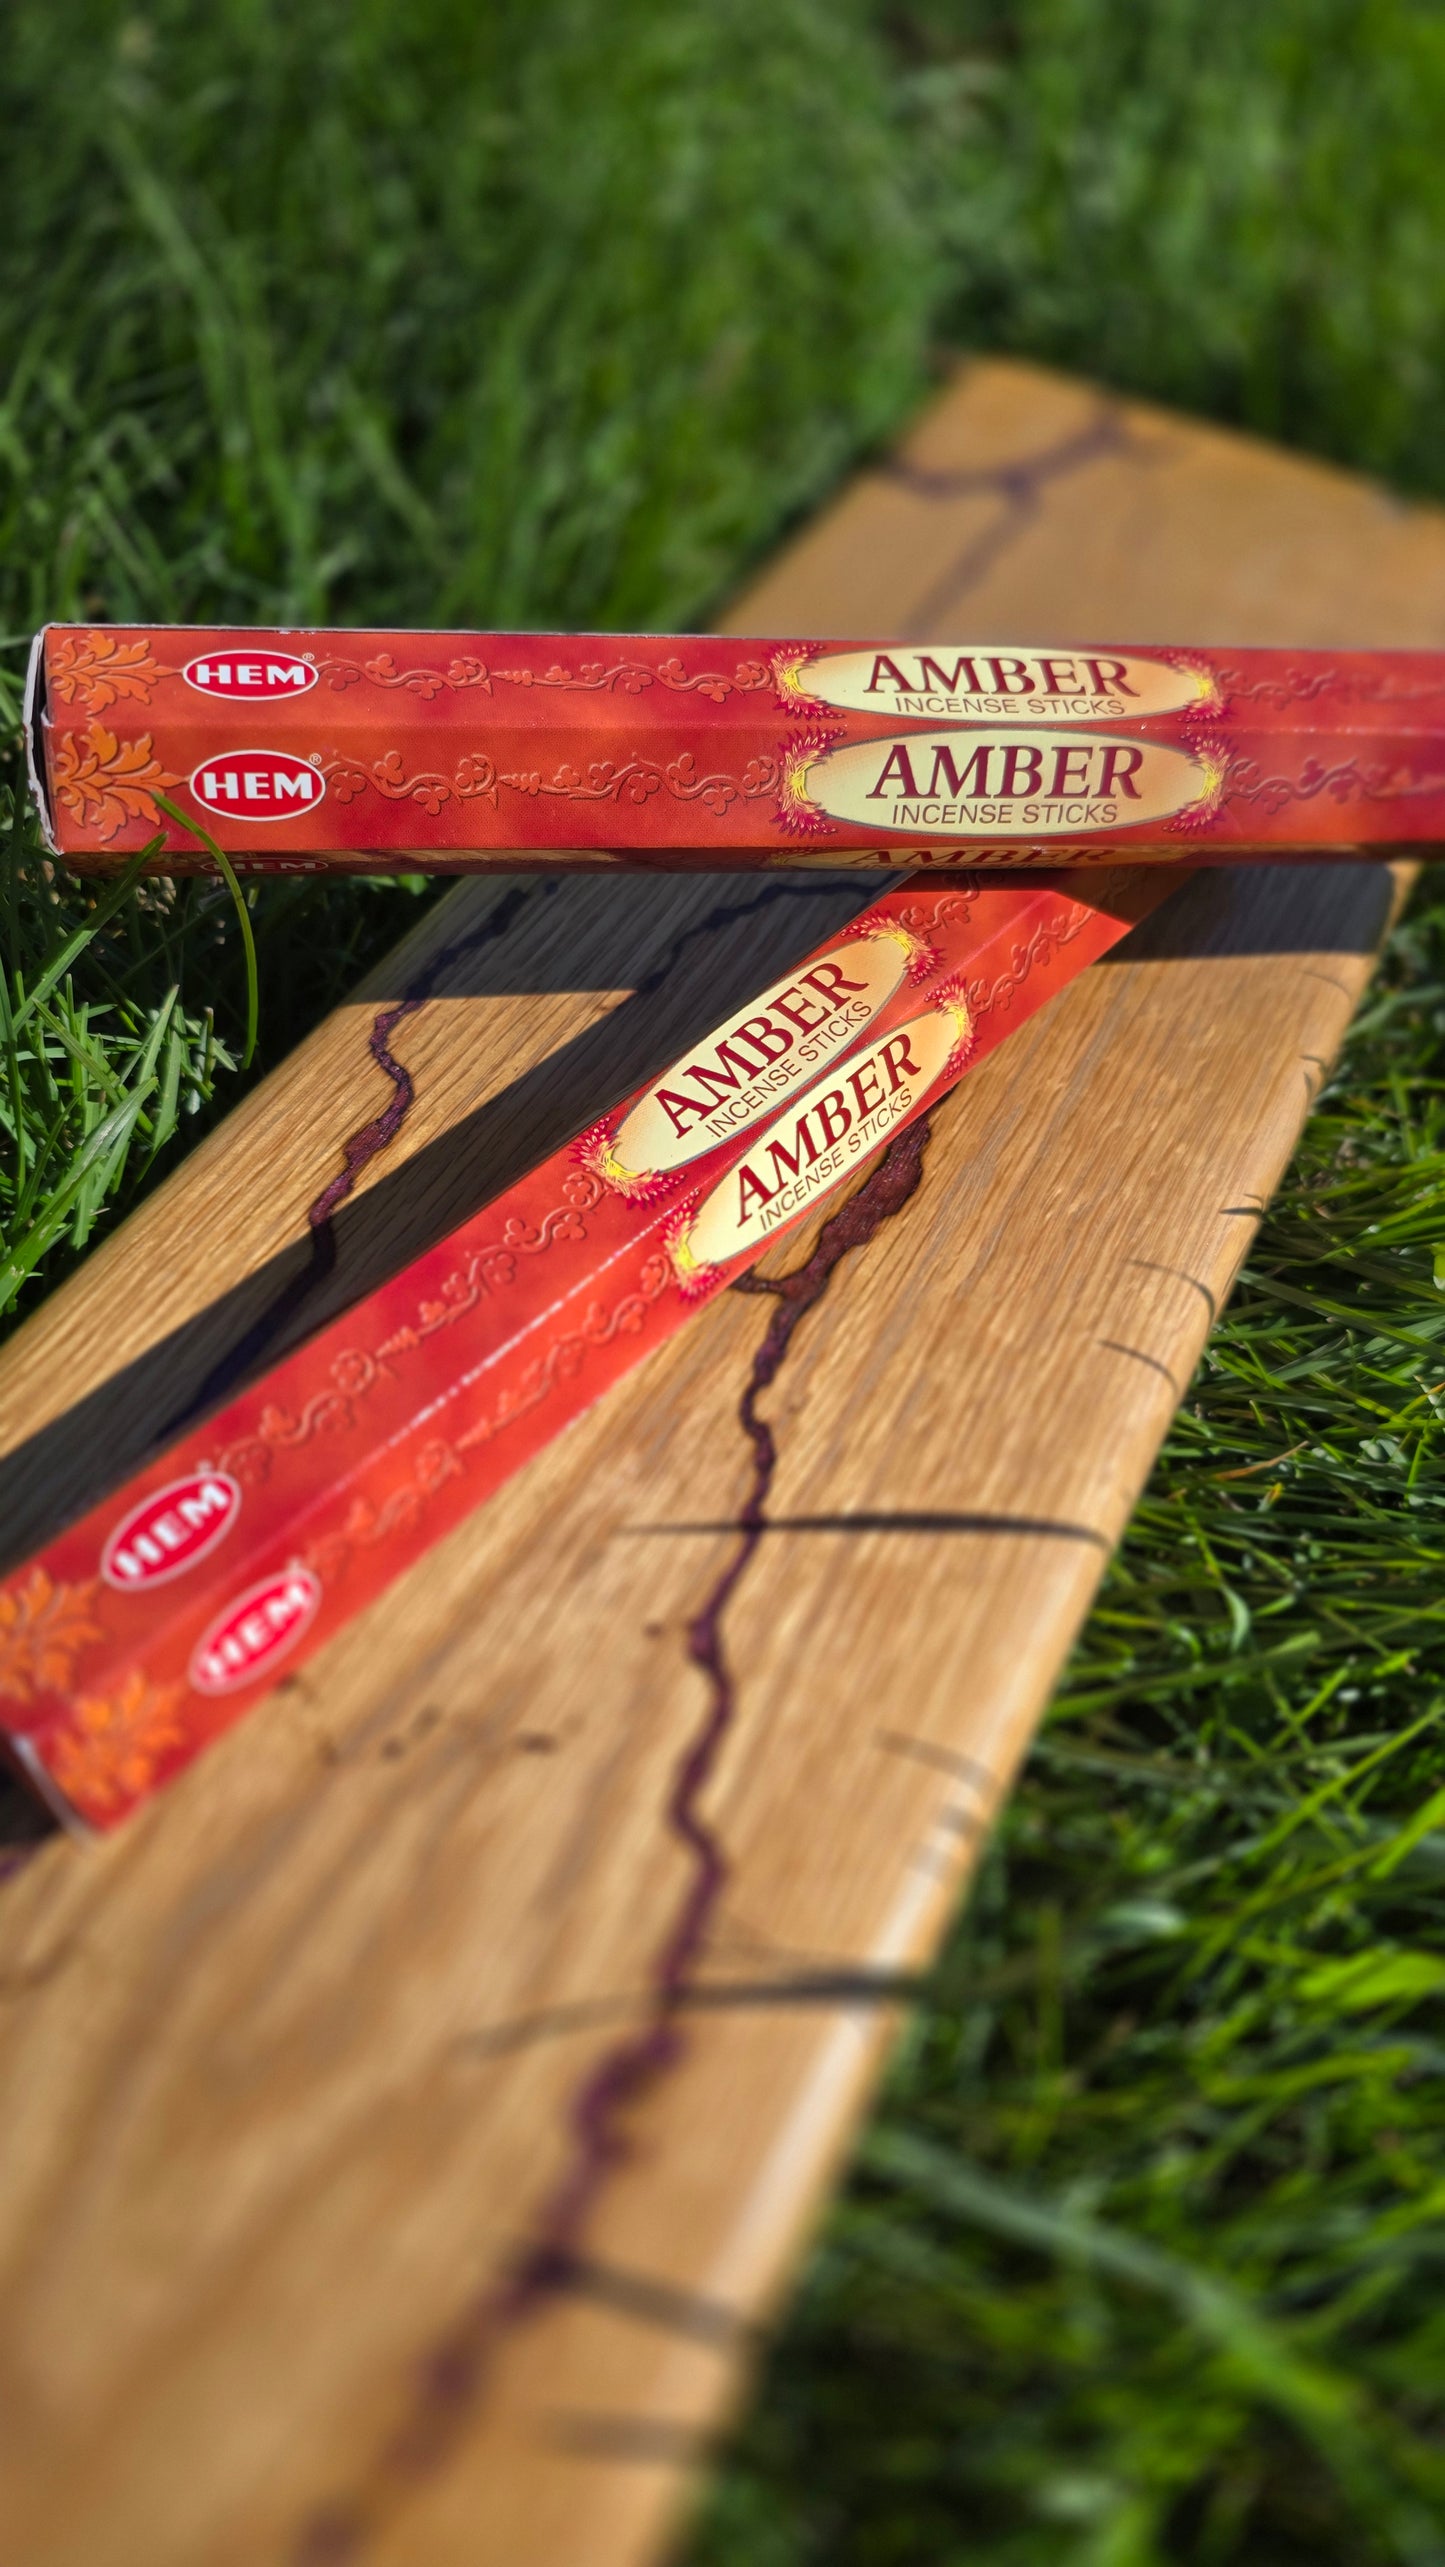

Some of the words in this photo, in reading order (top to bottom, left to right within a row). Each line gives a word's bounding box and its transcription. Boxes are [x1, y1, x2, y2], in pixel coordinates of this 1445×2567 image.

[197, 664, 305, 685] HEM
[863, 655, 1141, 697] AMBER
[895, 697, 1020, 714] INCENSE
[1029, 699, 1126, 715] STICKS
[203, 772, 313, 799] HEM
[866, 744, 1144, 800] AMBER
[892, 804, 1013, 825] INCENSE
[1022, 804, 1118, 824] STICKS
[843, 849, 1116, 864] AMBER
[654, 962, 869, 1139] AMBER
[706, 1059, 802, 1138] INCENSE
[798, 1001, 872, 1062] STICKS
[736, 1033, 921, 1227] AMBER
[760, 1151, 844, 1231] INCENSE
[849, 1087, 912, 1153] STICKS
[114, 1482, 230, 1579] HEM
